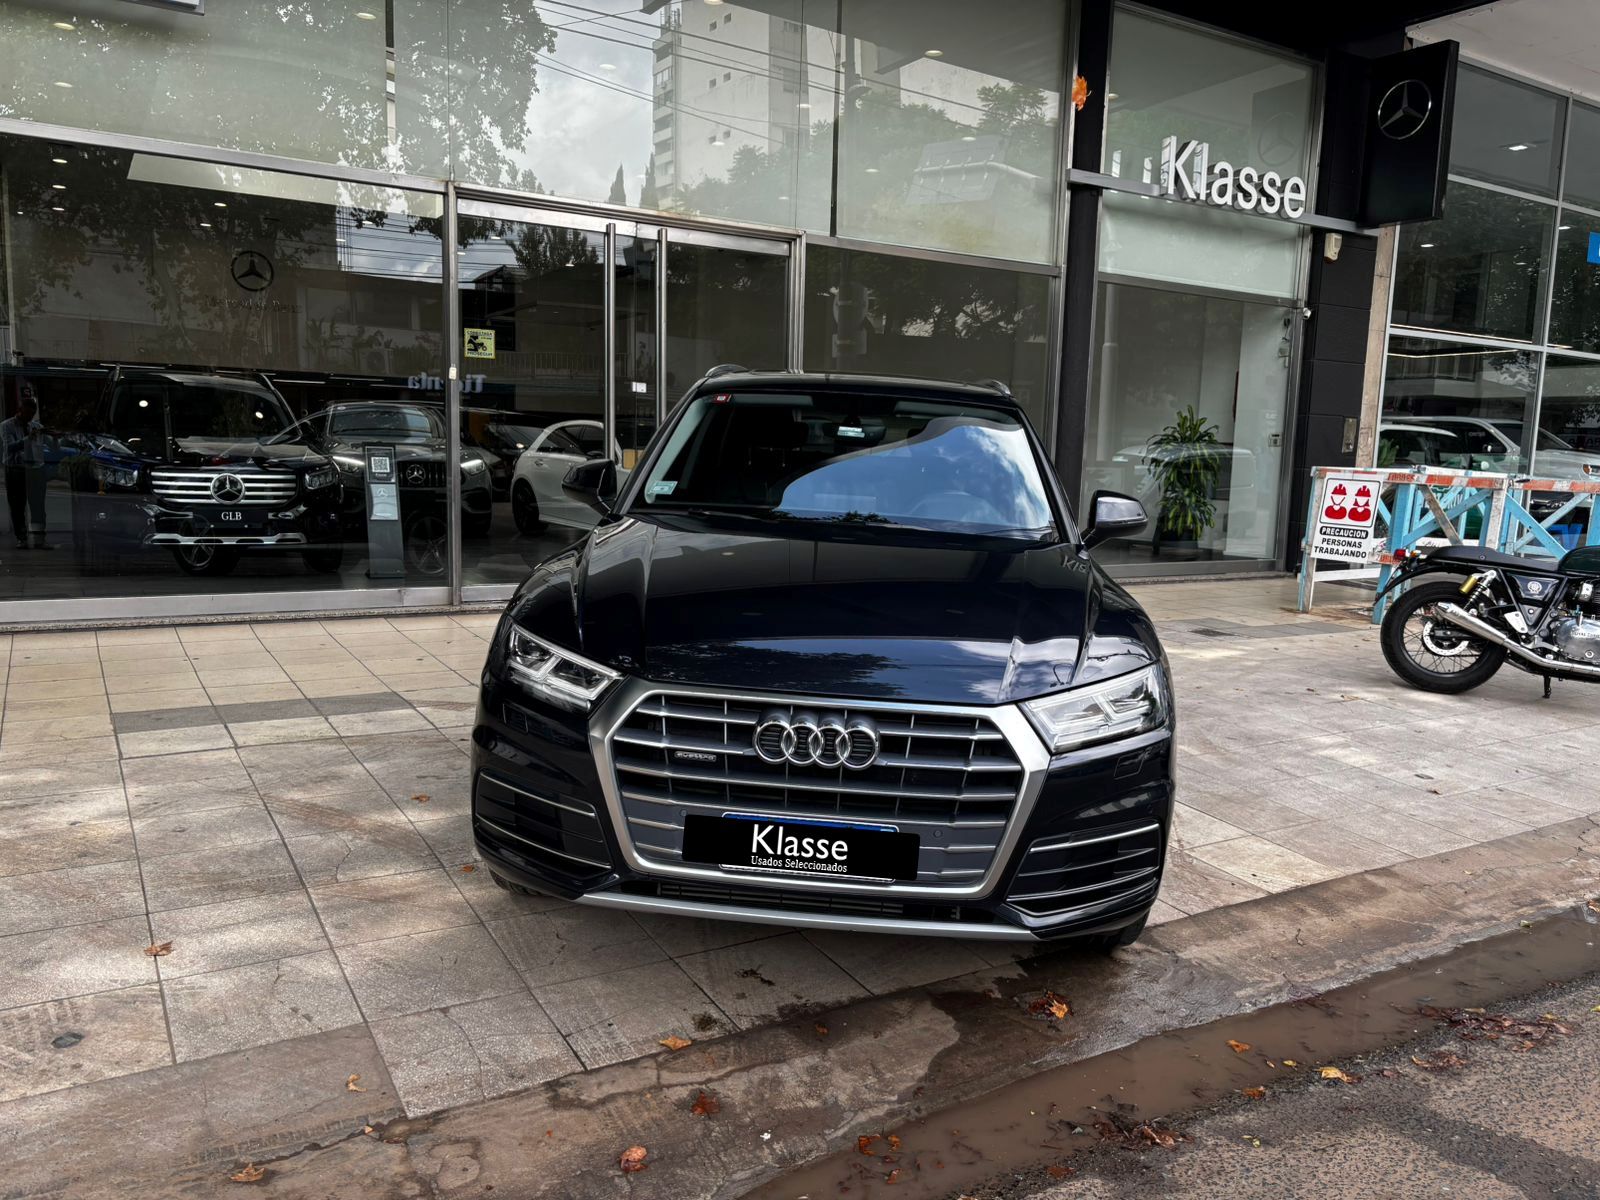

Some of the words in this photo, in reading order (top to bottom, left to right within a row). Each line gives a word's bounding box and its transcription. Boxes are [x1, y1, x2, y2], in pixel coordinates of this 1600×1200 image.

[1161, 135, 1306, 219] Klasse
[221, 511, 242, 521] GLB
[1321, 527, 1367, 538] PRECAUCION
[1321, 538, 1362, 549] PERSONAS
[1314, 546, 1367, 558] TRABAJANDO
